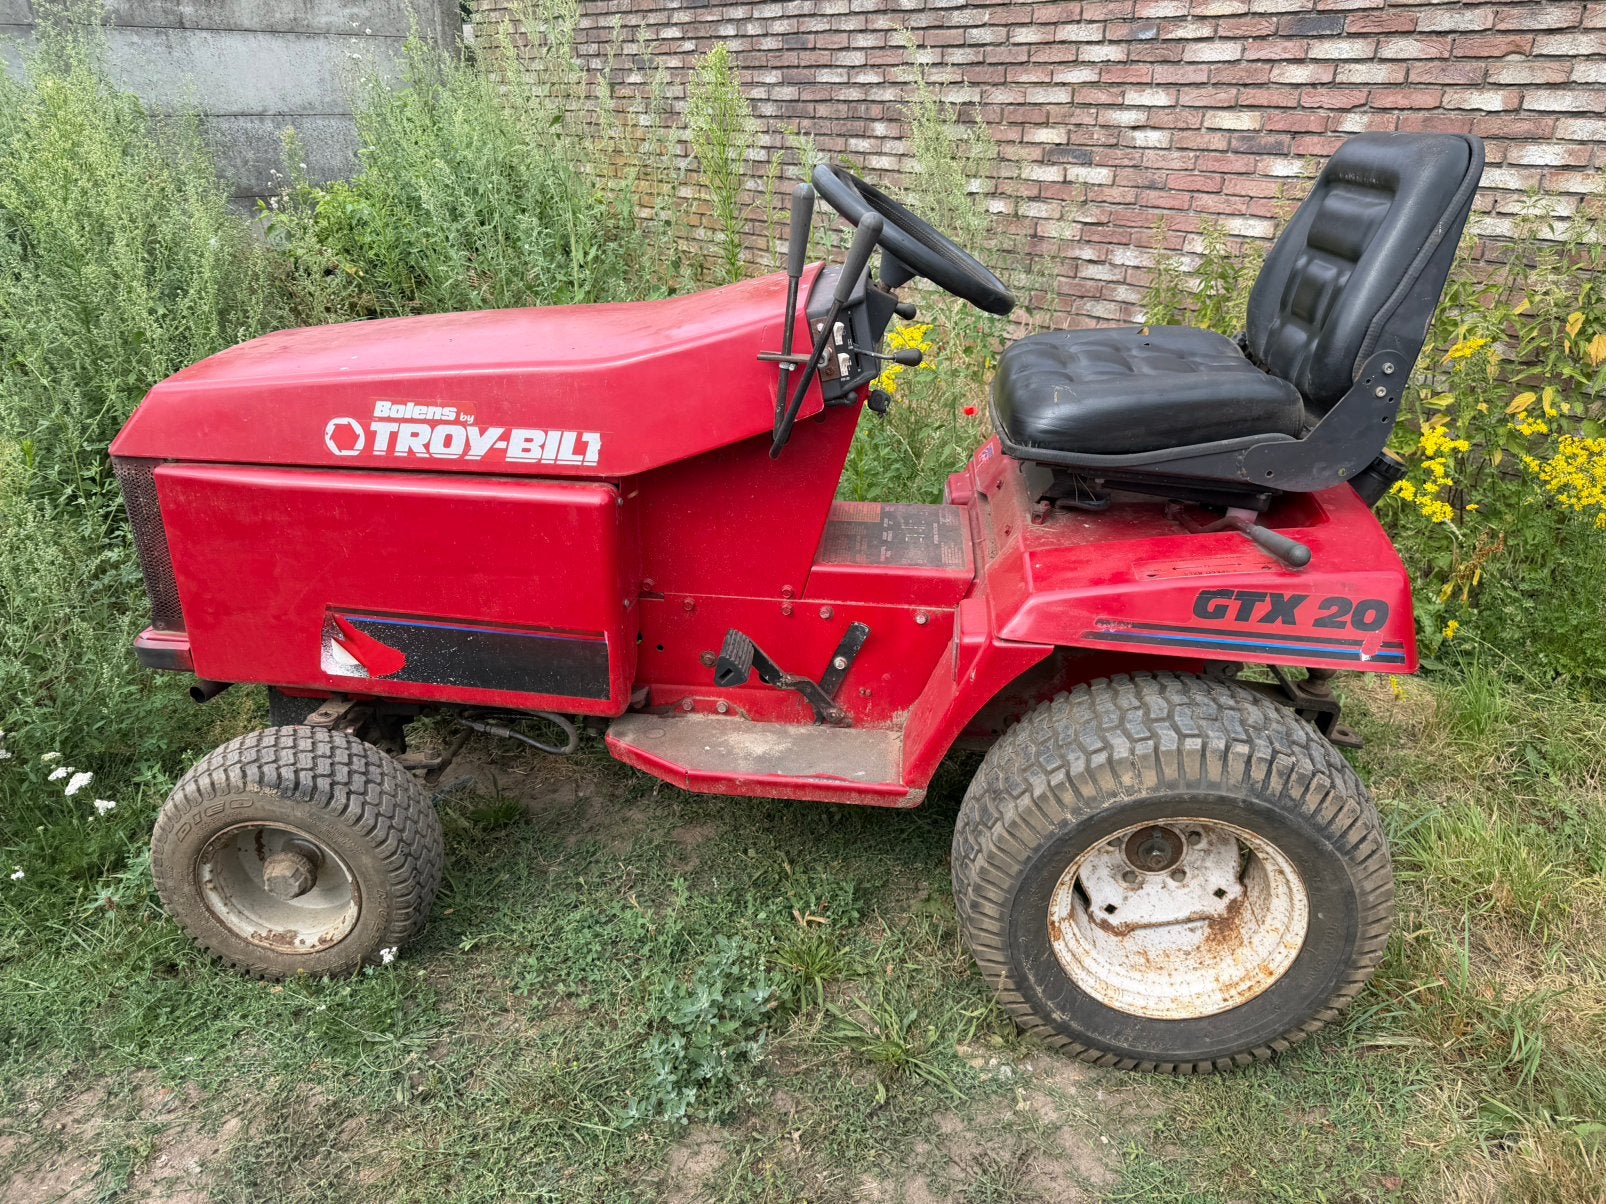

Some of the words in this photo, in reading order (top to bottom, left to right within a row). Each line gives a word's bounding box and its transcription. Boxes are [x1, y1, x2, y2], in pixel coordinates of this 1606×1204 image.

[374, 401, 456, 420] Bolens
[459, 412, 475, 424] by
[370, 421, 602, 466] TROY-BILT
[1193, 589, 1308, 625] GTX
[1313, 598, 1389, 631] 20
